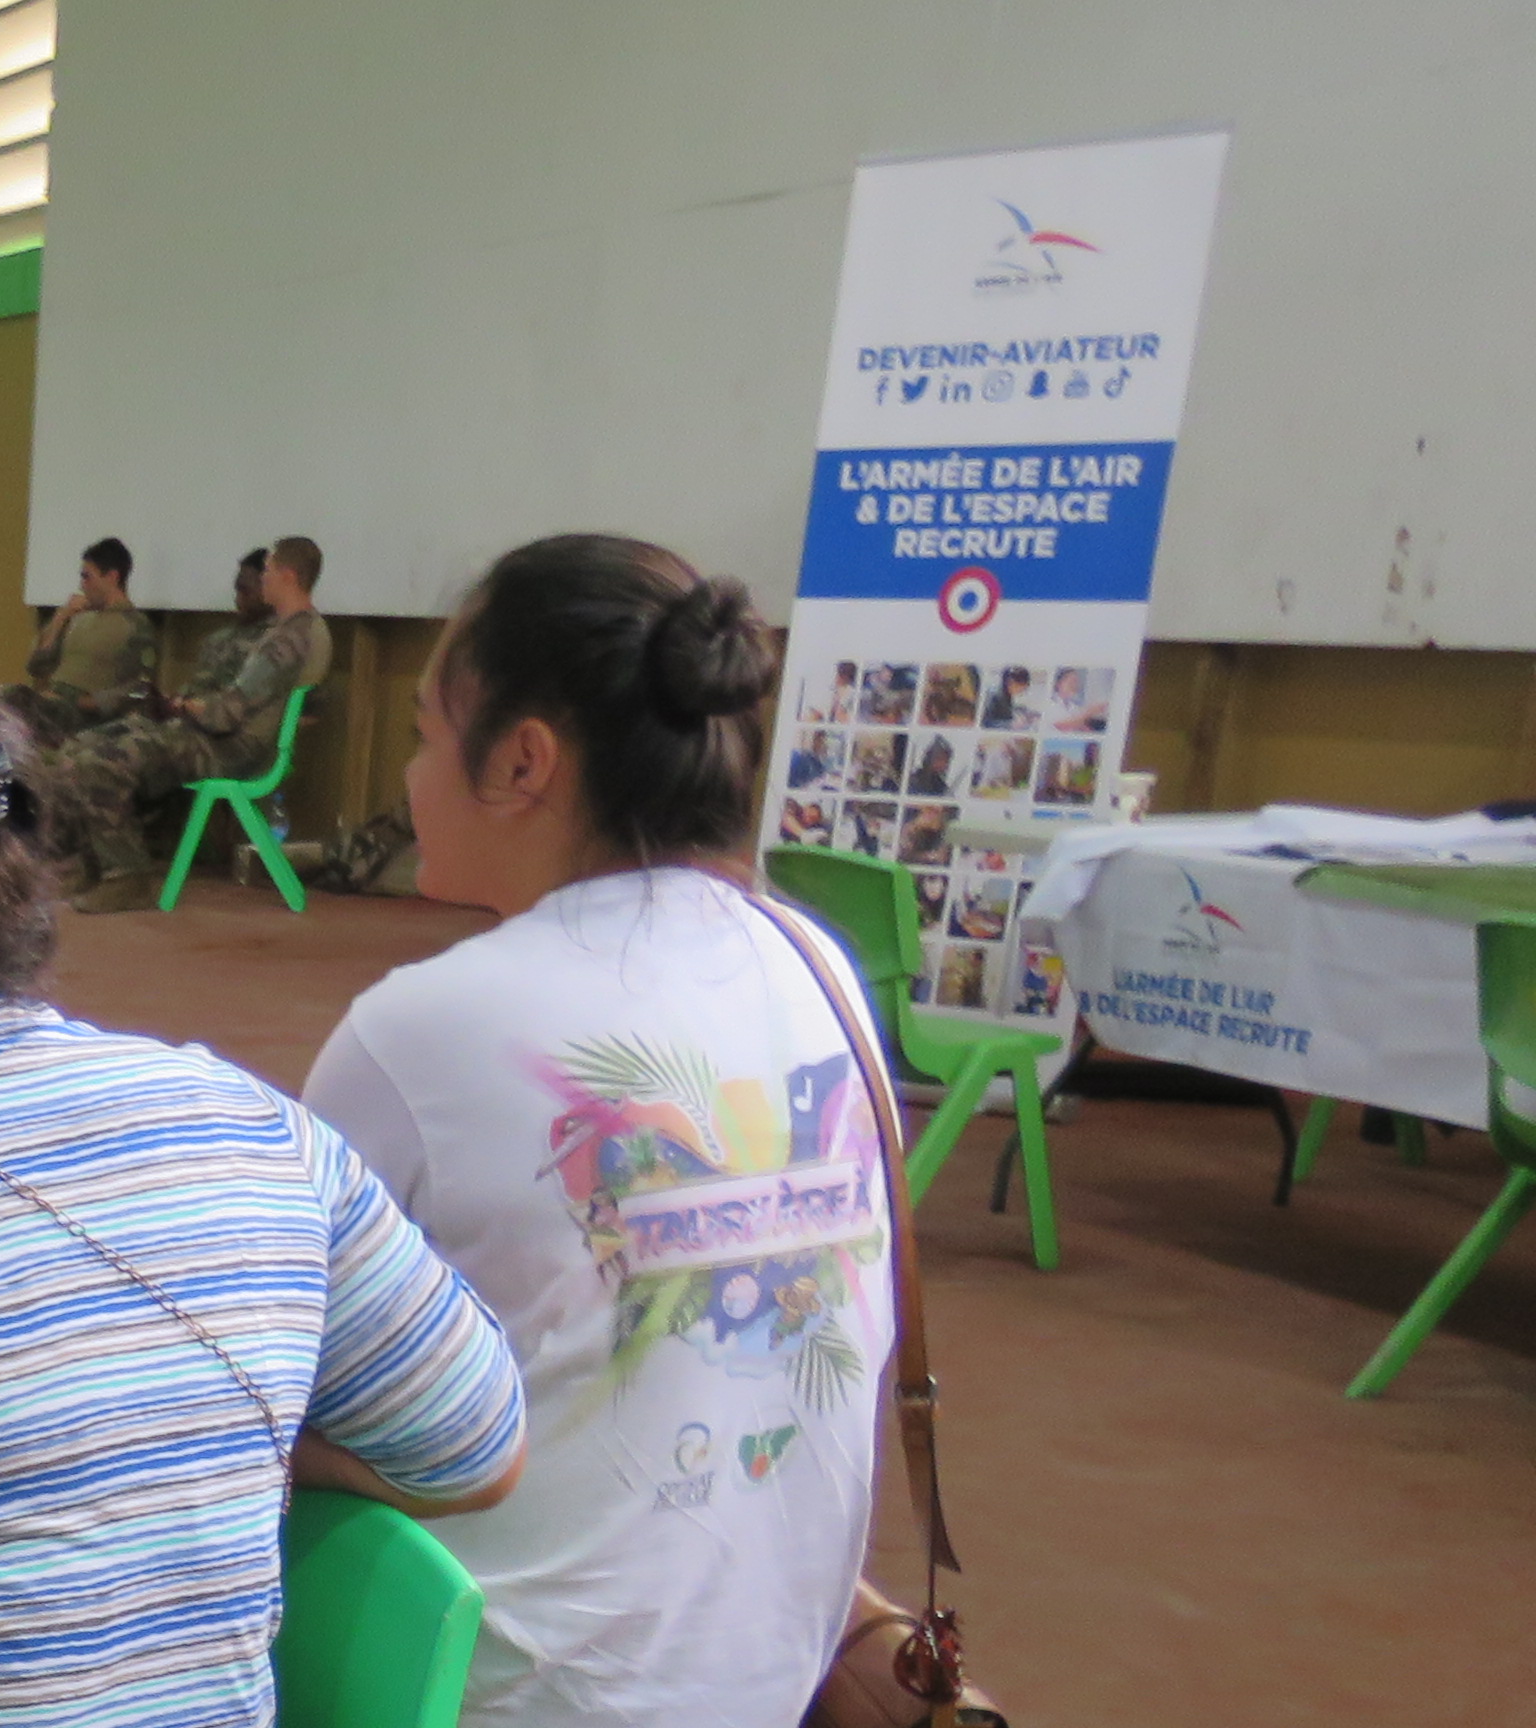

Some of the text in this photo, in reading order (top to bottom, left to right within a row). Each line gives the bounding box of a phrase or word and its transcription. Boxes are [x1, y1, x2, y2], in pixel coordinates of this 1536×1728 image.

[857, 332, 1162, 372] DEVENIR-AVIATEUR
[839, 452, 1144, 491] L'ARMÉE DE L'AIR
[855, 491, 1112, 525] & DE L'ESPACE
[893, 527, 1059, 559] RECRUTE
[1217, 1013, 1313, 1056] RECRUTE
